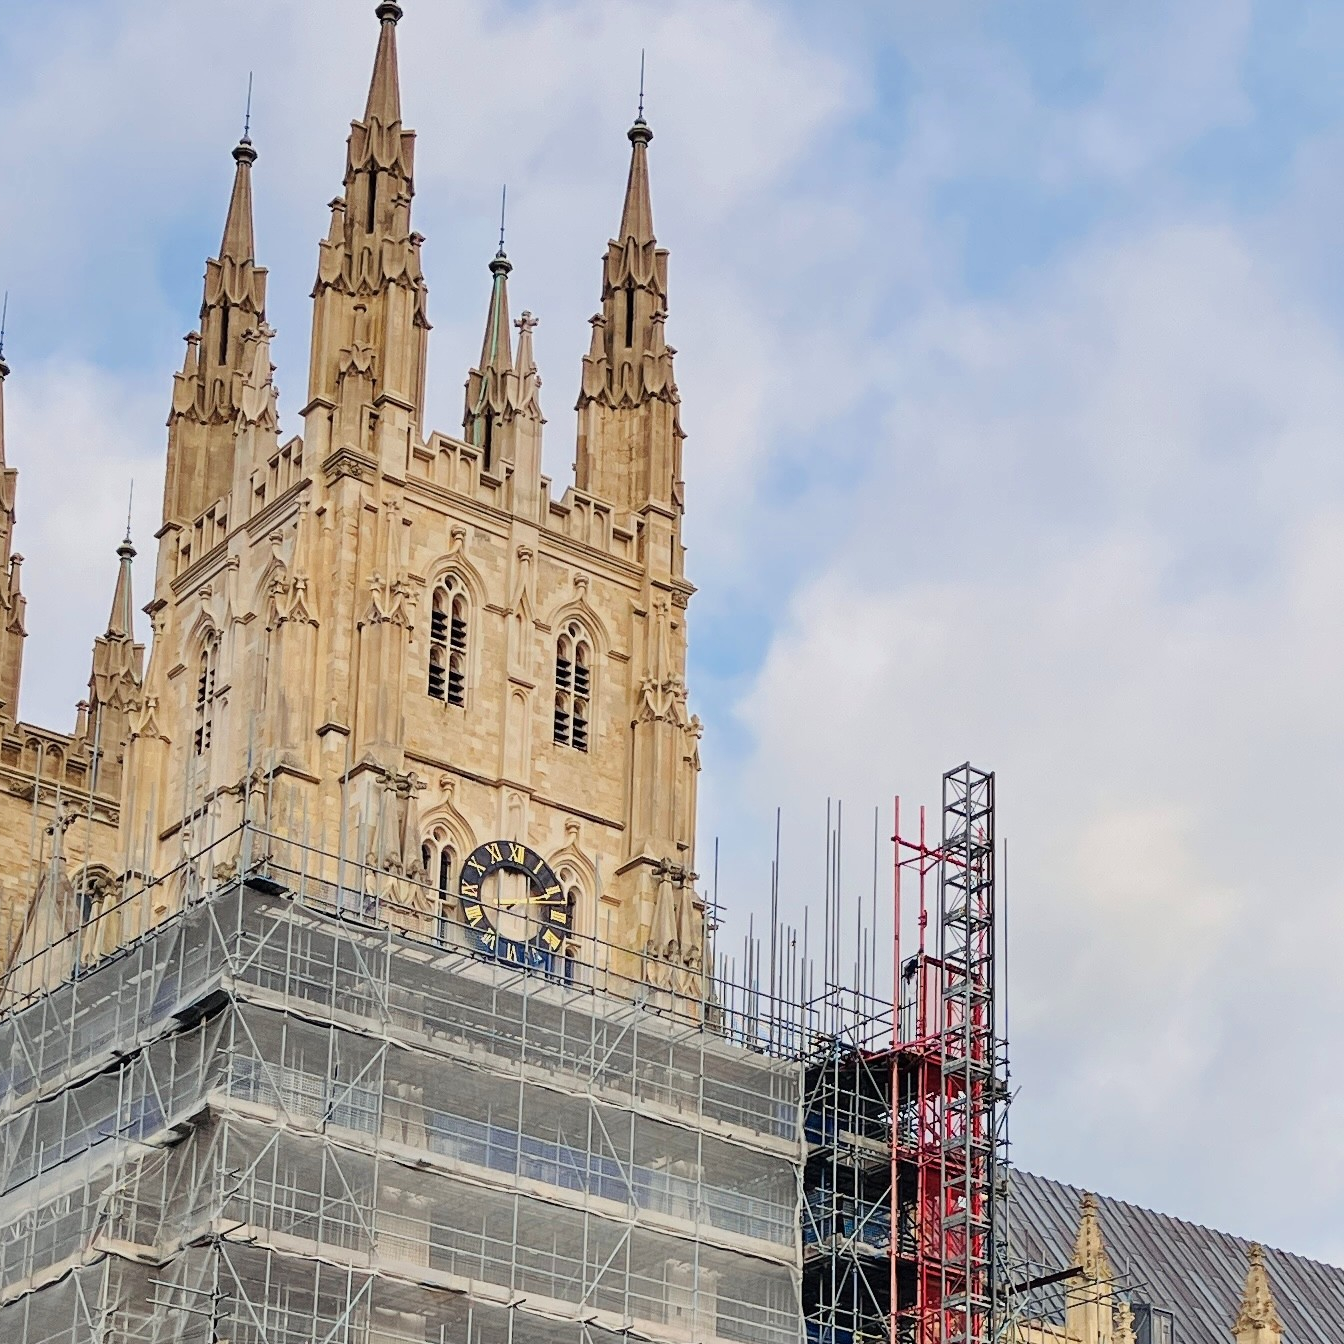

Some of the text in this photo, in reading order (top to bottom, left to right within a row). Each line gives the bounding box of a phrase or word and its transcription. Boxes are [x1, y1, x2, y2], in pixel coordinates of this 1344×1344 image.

[485, 843, 503, 864] XI
[507, 843, 525, 865] XII
[467, 855, 486, 877] X
[532, 859, 544, 875] I
